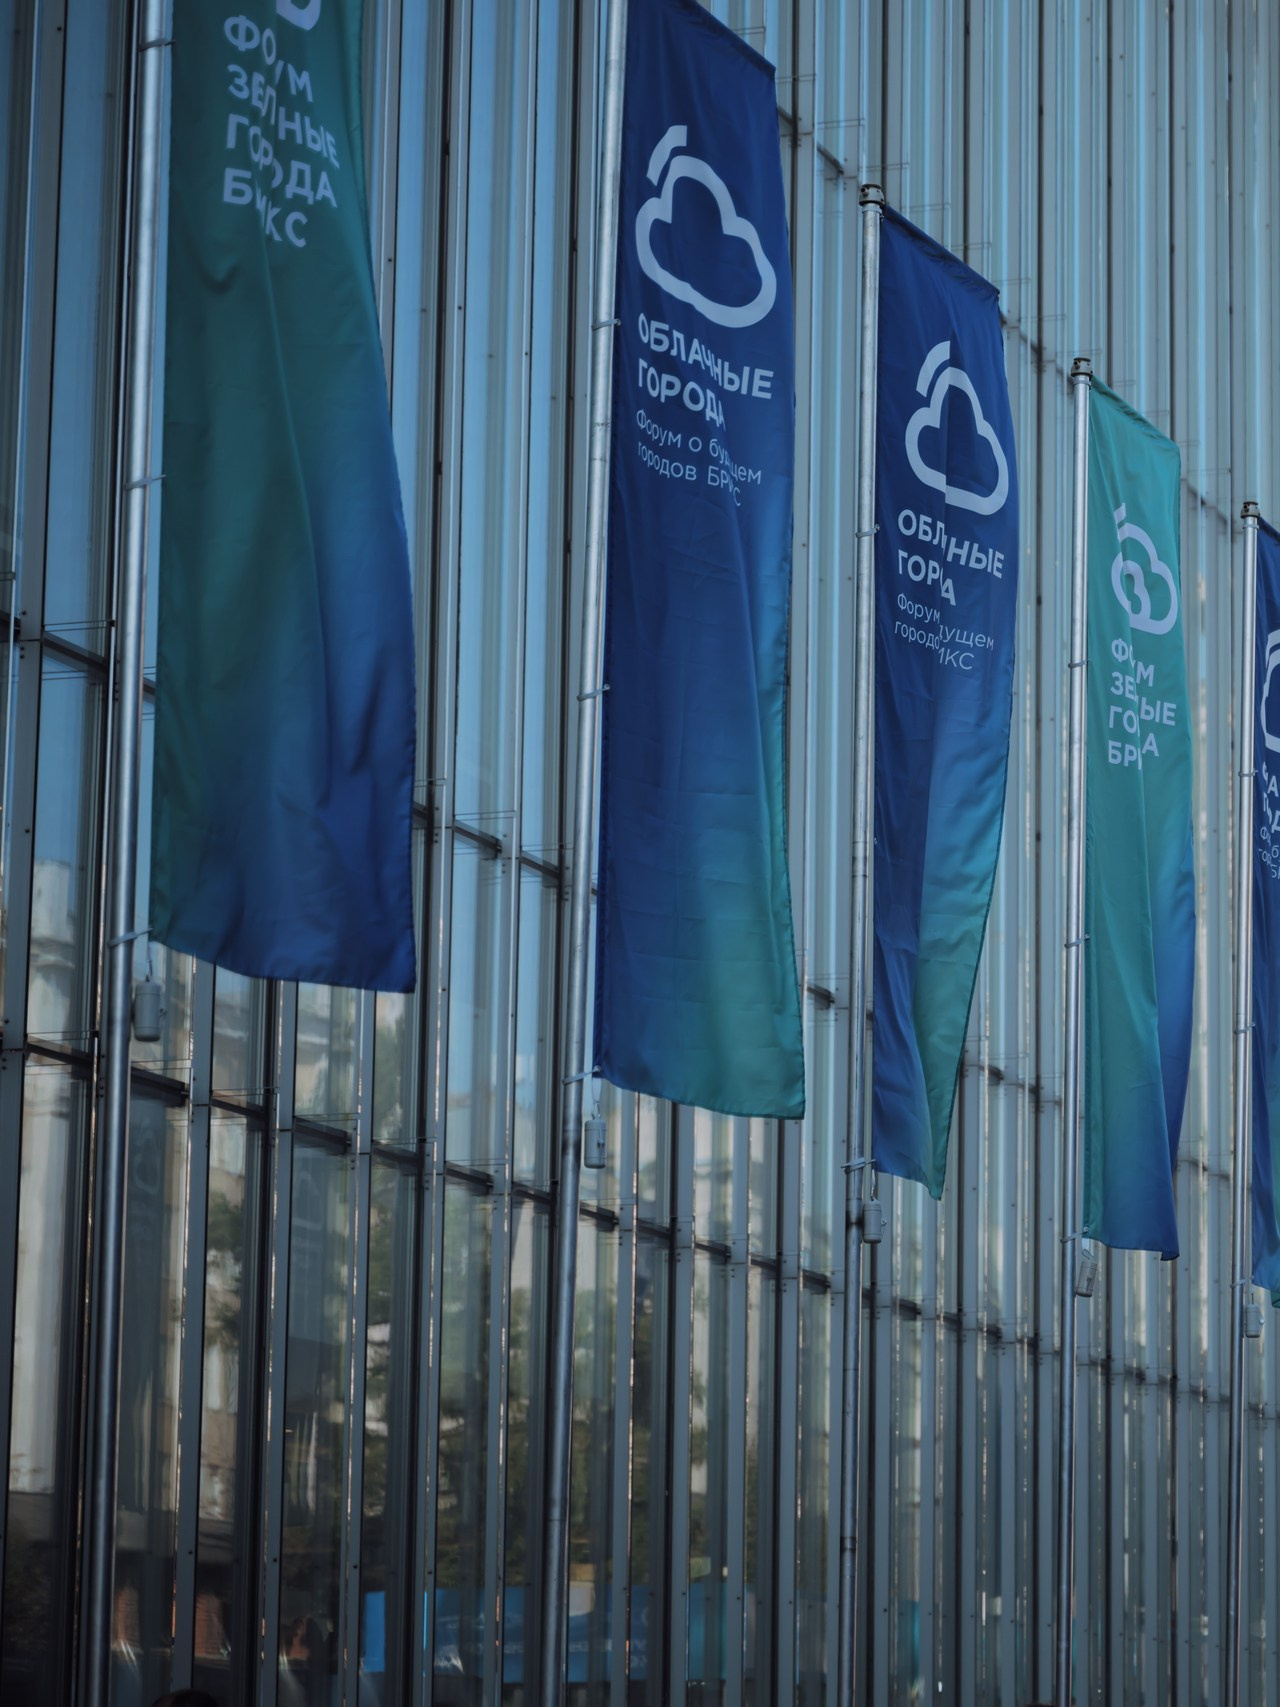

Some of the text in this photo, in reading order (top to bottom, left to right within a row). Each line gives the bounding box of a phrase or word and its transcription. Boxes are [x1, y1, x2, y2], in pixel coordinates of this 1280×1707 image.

[224, 14, 313, 102] ФОМ
[227, 64, 340, 169] ЗЕЛНЫЕ
[638, 313, 774, 399] ОБЛАЧНЫЕ
[638, 358, 726, 431] ГОРОДА
[636, 409, 682, 448] Форум
[688, 436, 702, 452] о
[638, 441, 697, 482] городов
[898, 509, 1005, 579] ОБЛНЫЕ
[895, 621, 940, 650] городо
[897, 593, 940, 624] Форум
